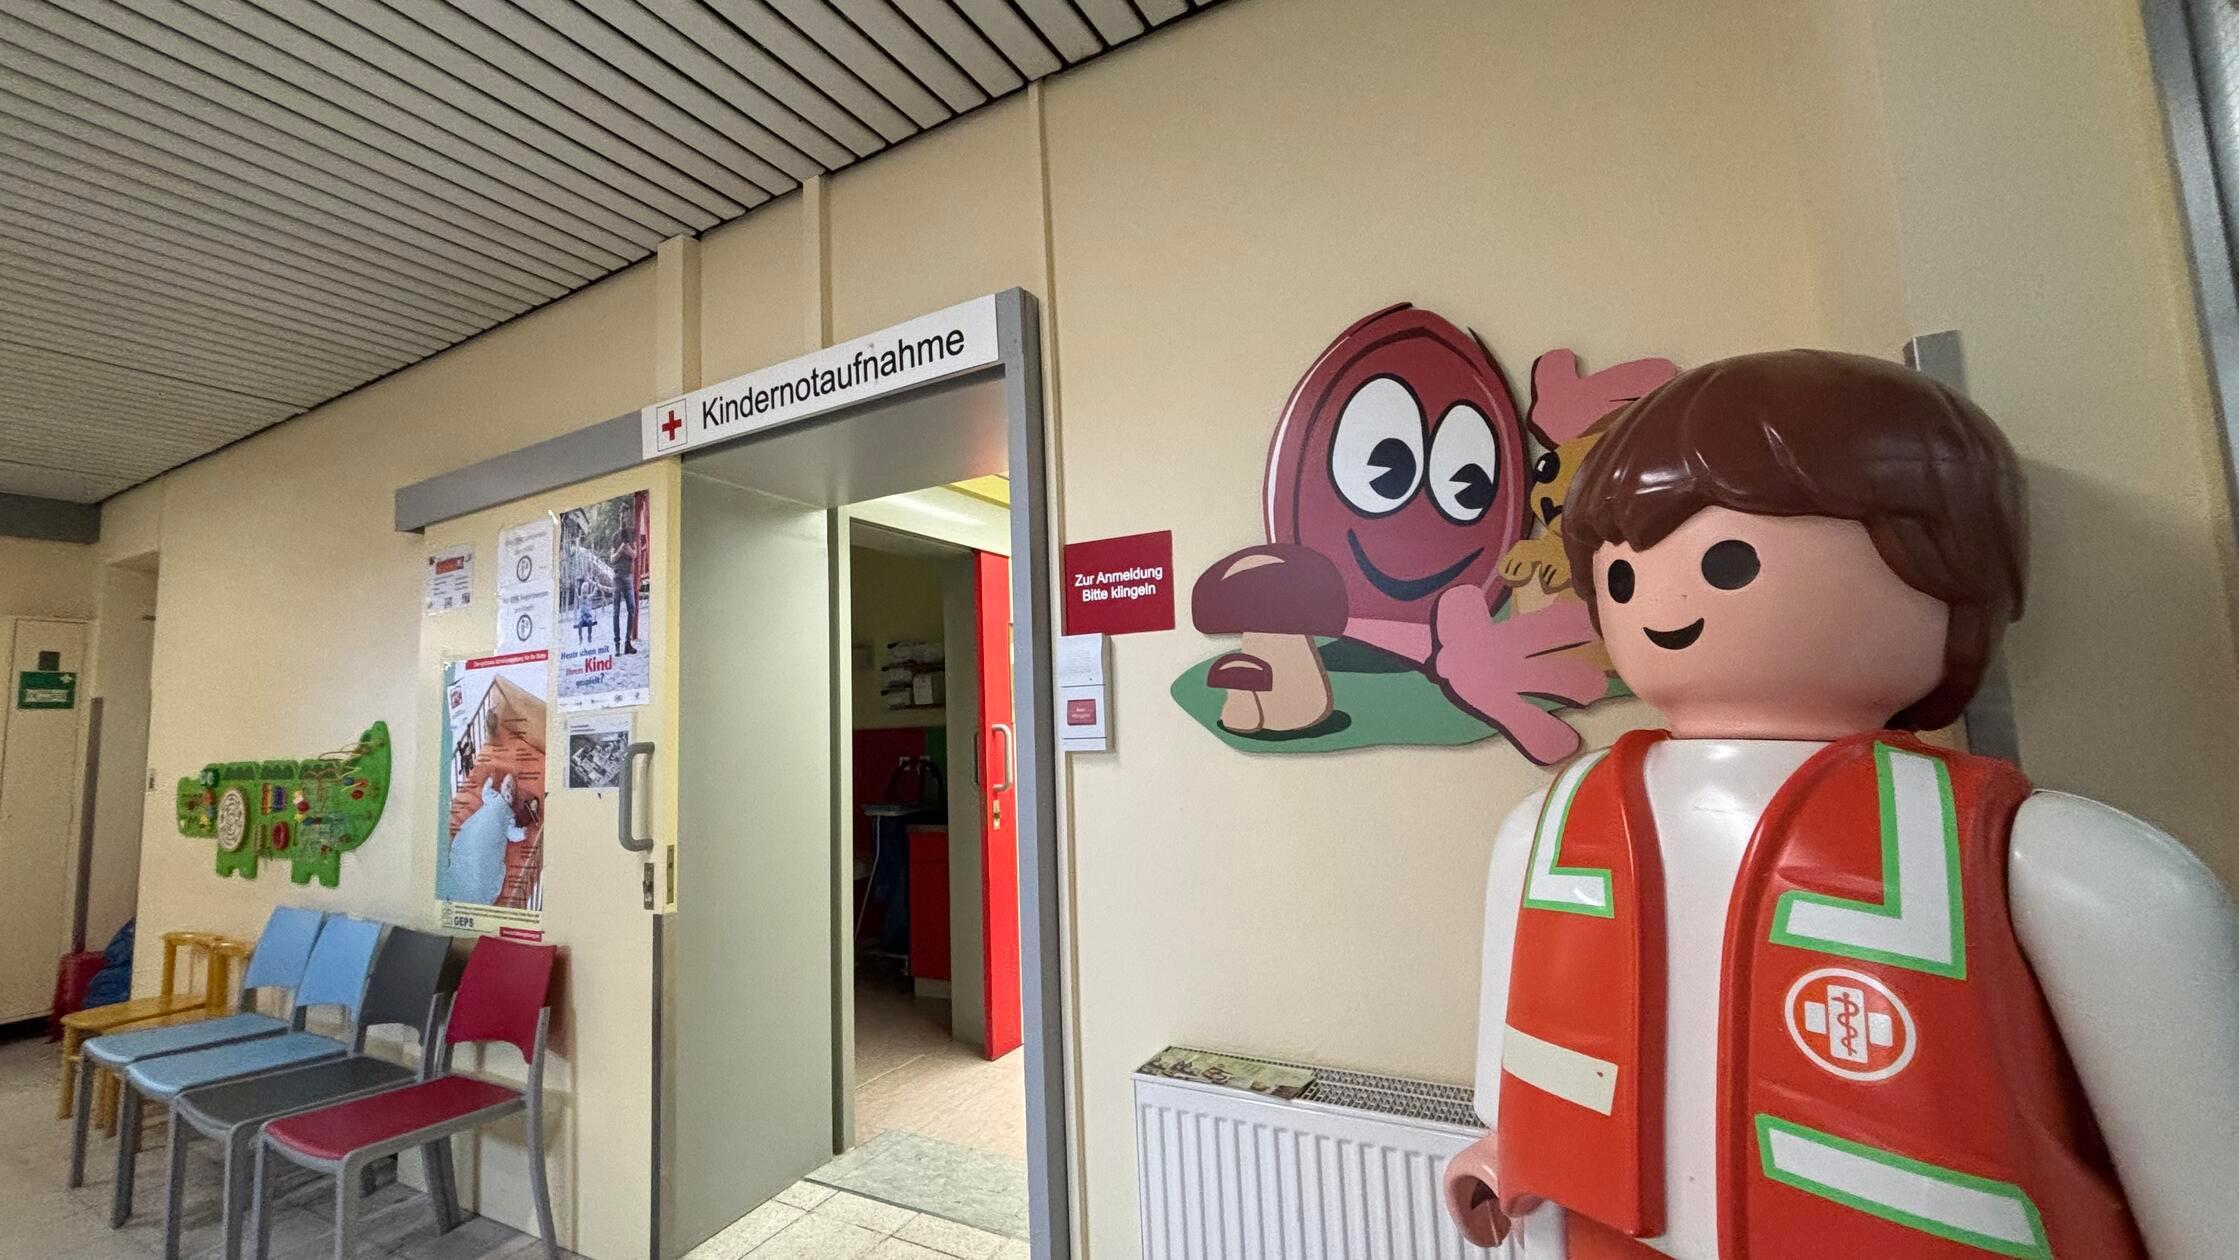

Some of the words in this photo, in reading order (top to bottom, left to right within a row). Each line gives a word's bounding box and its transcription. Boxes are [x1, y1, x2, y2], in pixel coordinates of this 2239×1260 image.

[702, 329, 965, 430] Kindernotaufnahme
[1075, 574, 1095, 587] Zur
[1096, 566, 1163, 584] Anmeldung
[1082, 588, 1108, 602] Bitte
[1111, 583, 1156, 599] klingeln
[561, 652, 578, 660] Heute
[579, 648, 596, 657] schon
[597, 645, 609, 654] mit
[585, 655, 612, 673] Kind
[454, 916, 474, 928] GEPS
